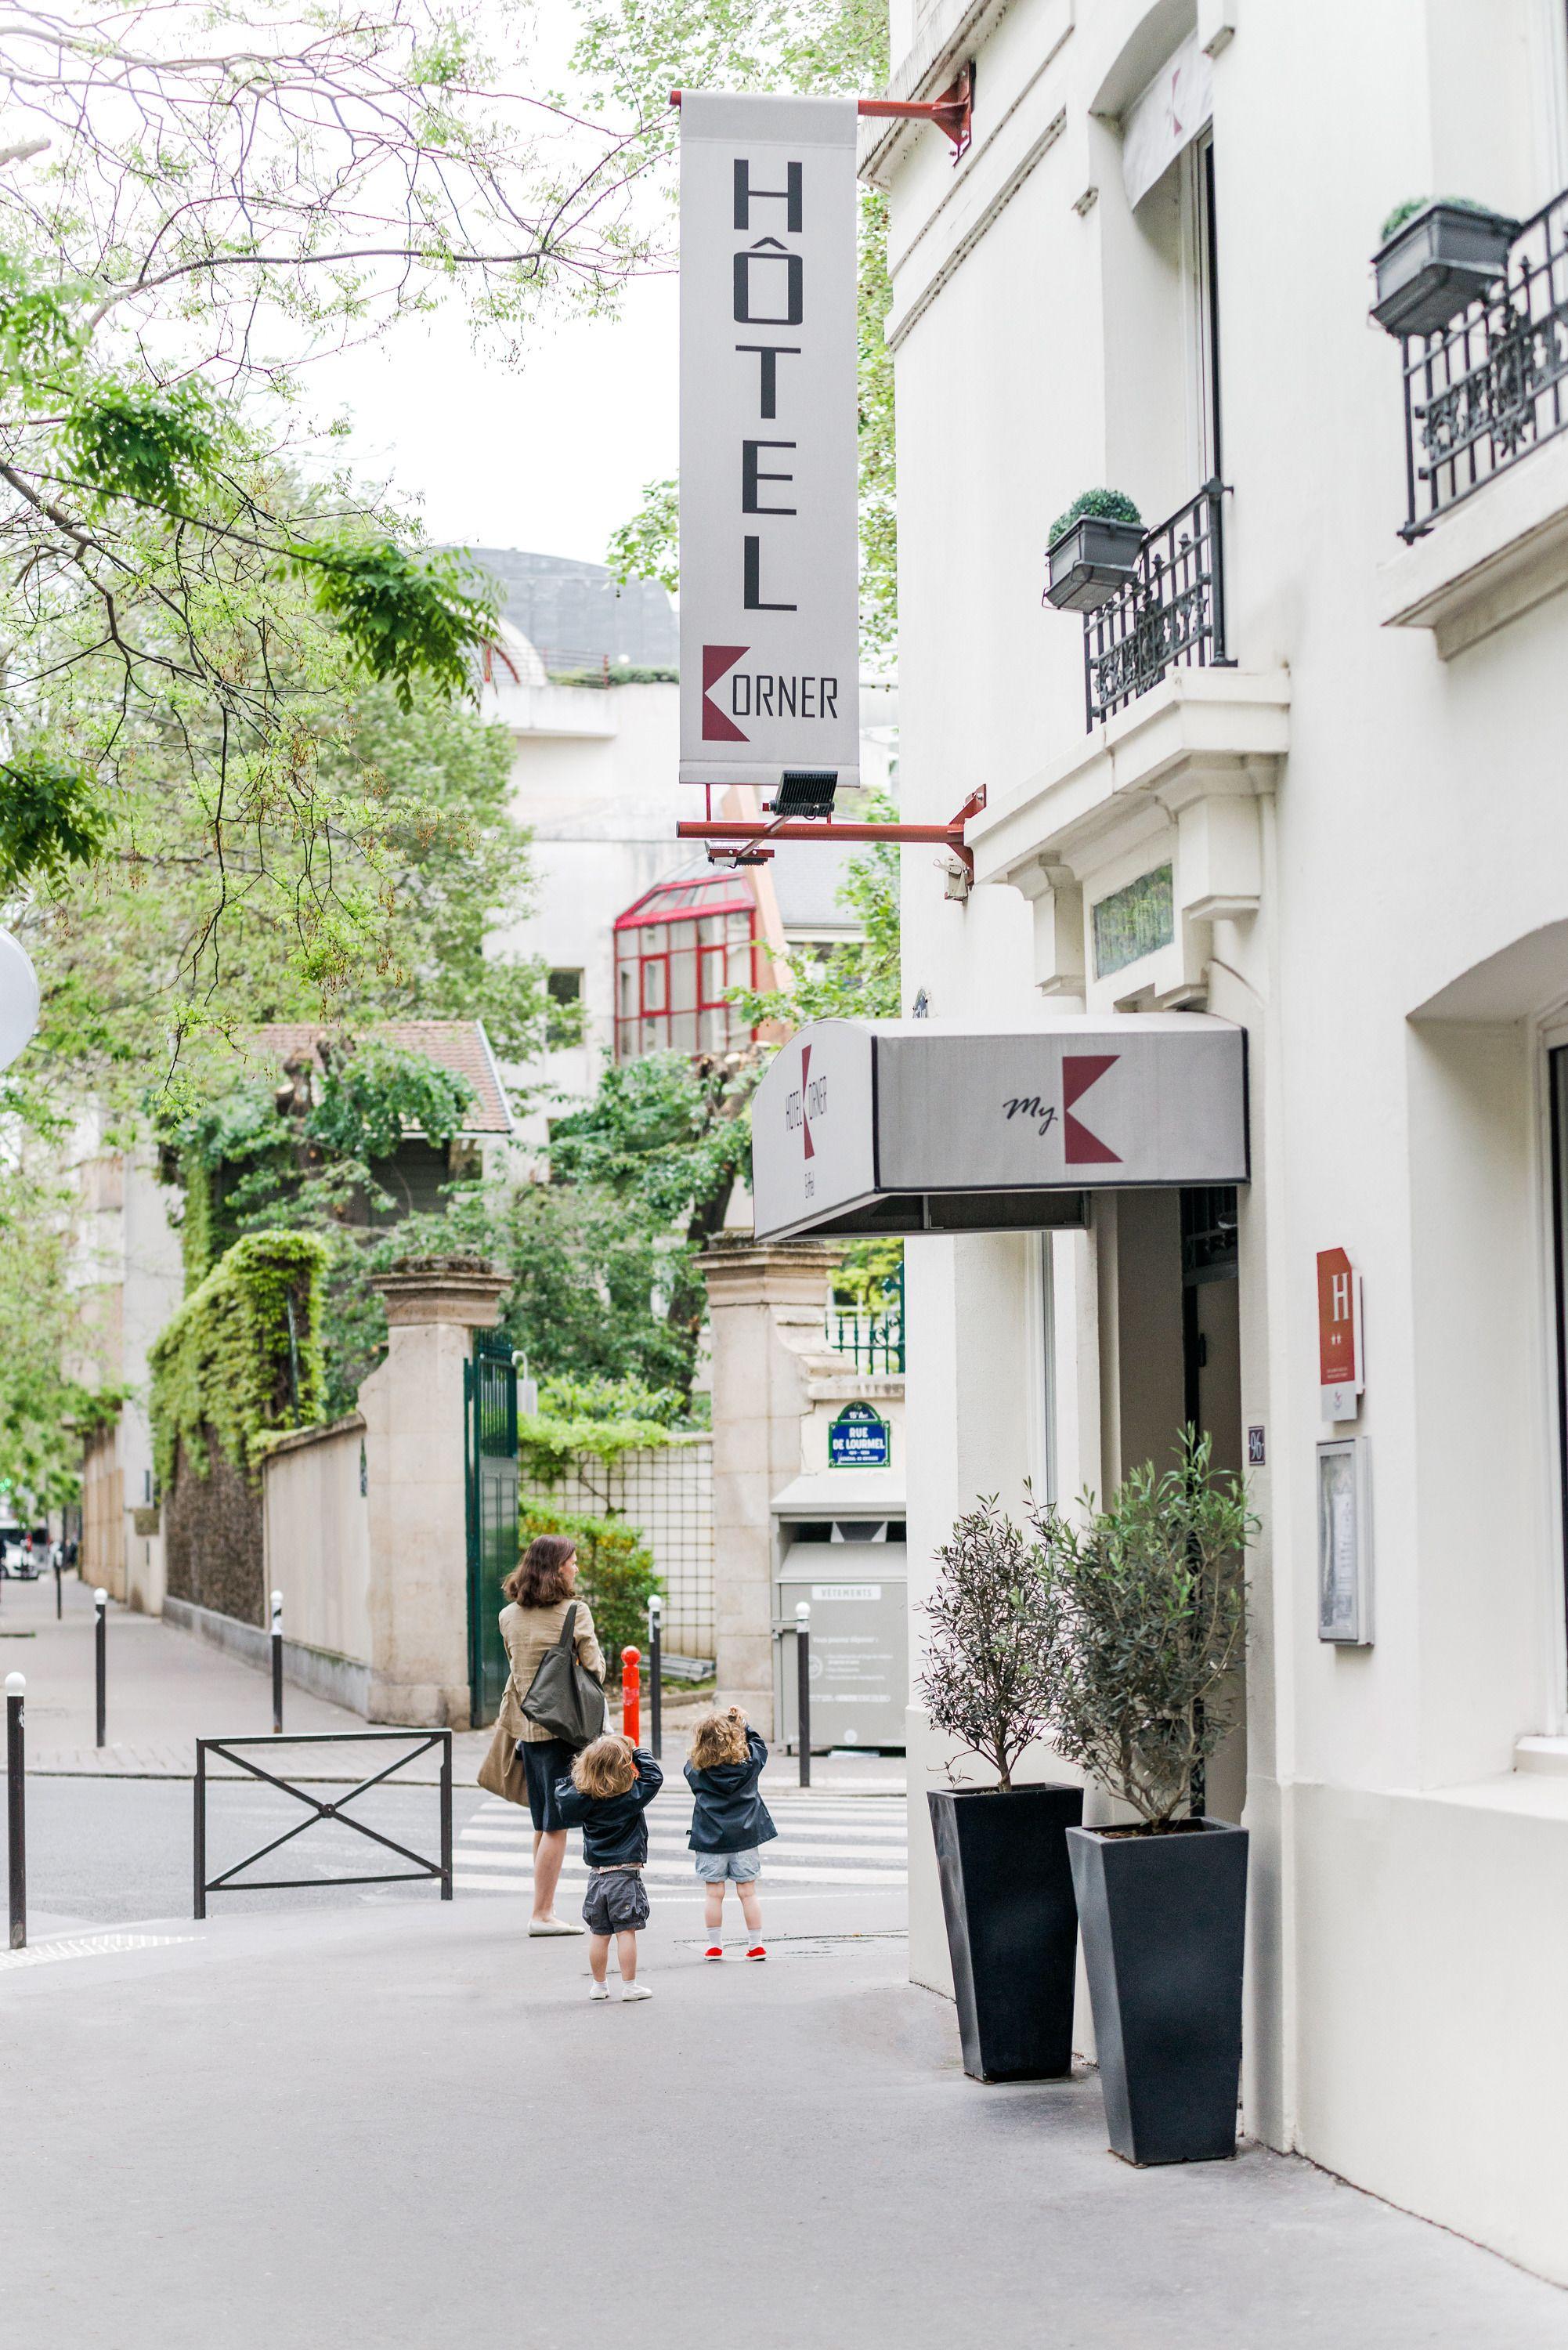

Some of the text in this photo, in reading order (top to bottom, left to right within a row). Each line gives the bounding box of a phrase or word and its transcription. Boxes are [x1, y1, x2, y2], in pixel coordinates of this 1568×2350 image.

[733, 158, 803, 611] HÔTEL
[702, 645, 838, 742] KORNER
[1003, 1097, 1058, 1136] My
[1331, 1272, 1349, 1322] H
[833, 1438, 885, 1450] DE LOURMEL
[849, 1426, 869, 1438] RUE
[1250, 1432, 1262, 1460] 96
[821, 1588, 873, 1598] VÊTEMENTS
